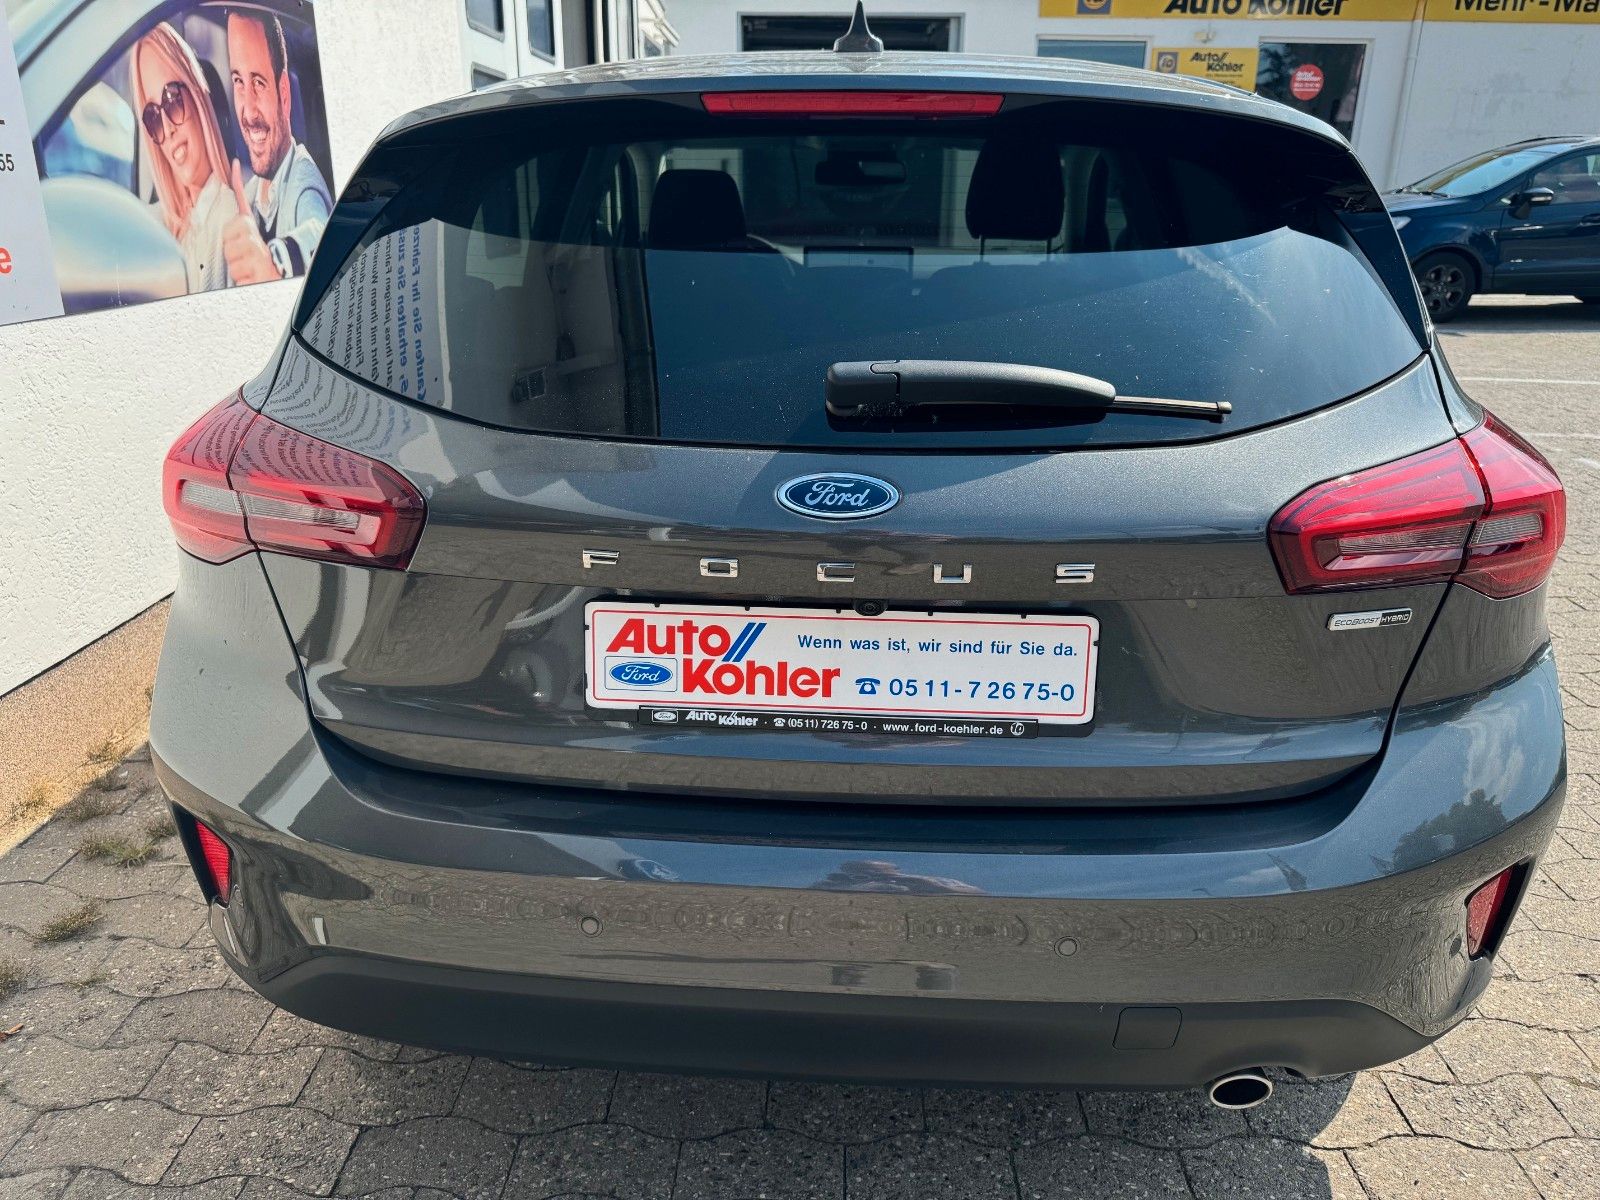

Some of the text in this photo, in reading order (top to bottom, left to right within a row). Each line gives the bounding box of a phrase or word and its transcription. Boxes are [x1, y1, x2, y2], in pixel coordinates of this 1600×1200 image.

[804, 480, 870, 507] Ford
[582, 548, 1096, 585] FOCUS
[606, 618, 731, 656] Auto
[798, 634, 1078, 657] Wenn was ist, wir sind für Sie da.
[620, 664, 661, 683] Ford
[685, 710, 717, 721] Auto
[882, 722, 1004, 735] www.ford-koehler.de
